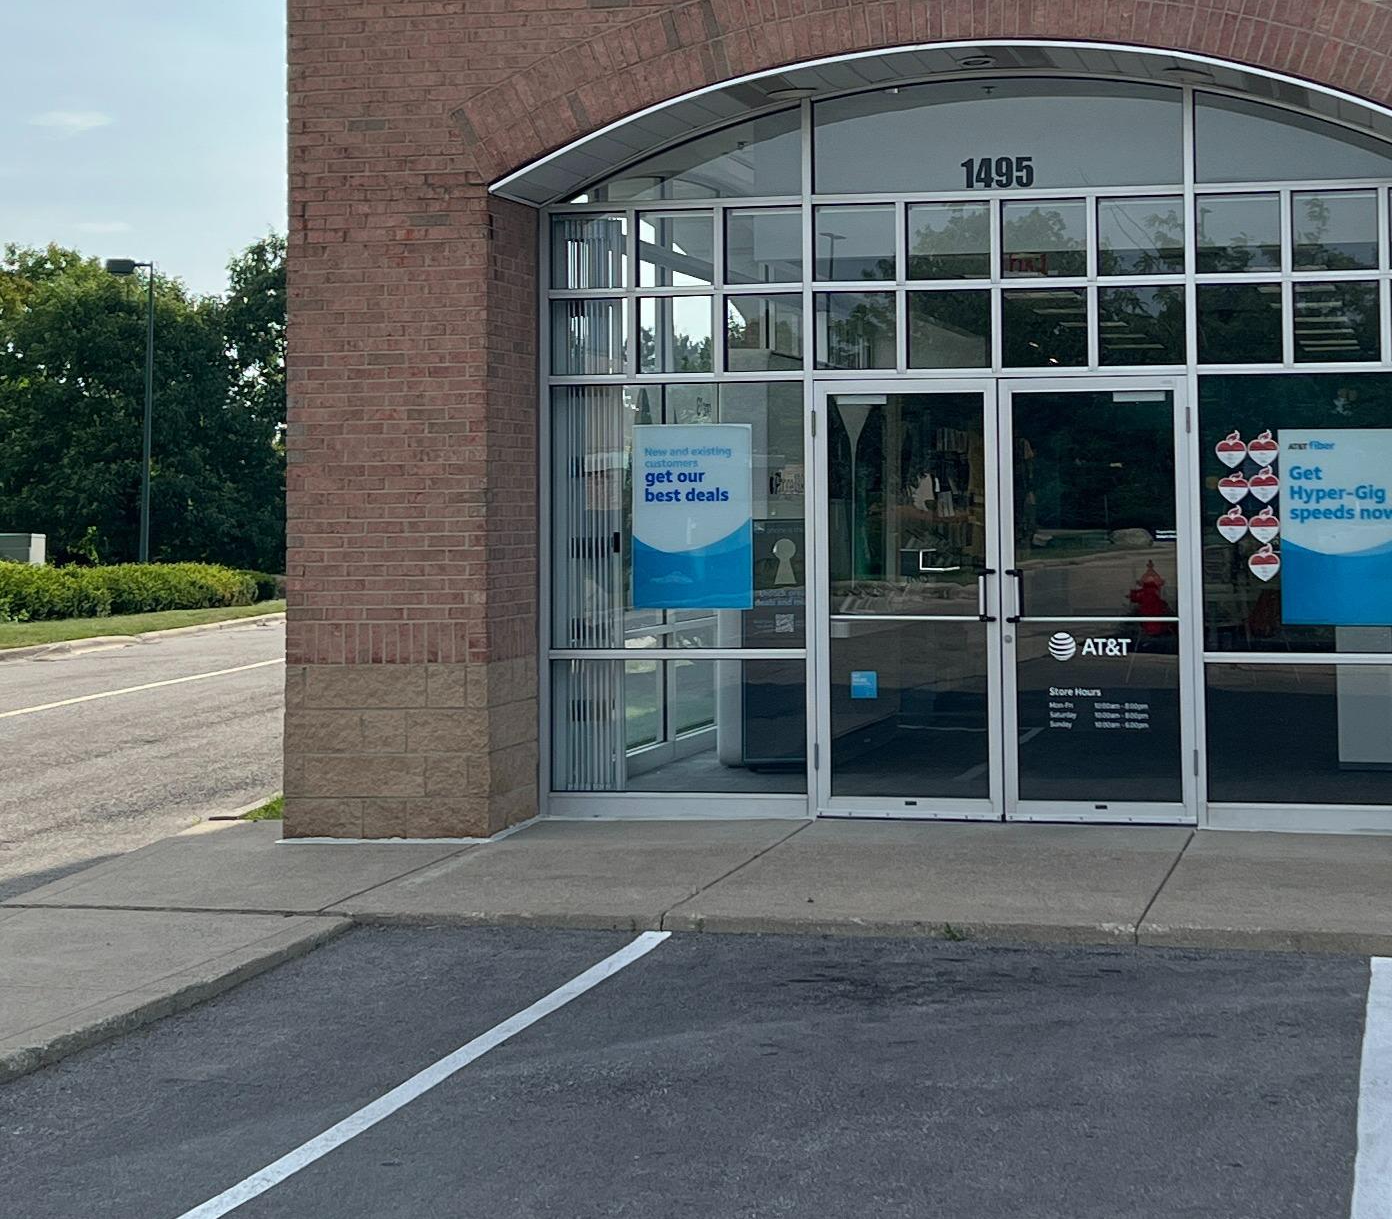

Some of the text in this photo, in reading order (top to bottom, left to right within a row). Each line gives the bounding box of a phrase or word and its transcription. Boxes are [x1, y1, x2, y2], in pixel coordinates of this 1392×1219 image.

[961, 156, 1034, 188] 1495
[644, 446, 732, 458] New and existing
[645, 459, 699, 468] customers
[645, 470, 706, 487] get our
[1288, 465, 1323, 480] Get
[645, 487, 730, 502] best deals
[1289, 484, 1386, 504] Hyper-Gig
[1289, 504, 1355, 524] speeds
[1081, 638, 1132, 656] AT&T
[1049, 687, 1102, 697] Store Hours
